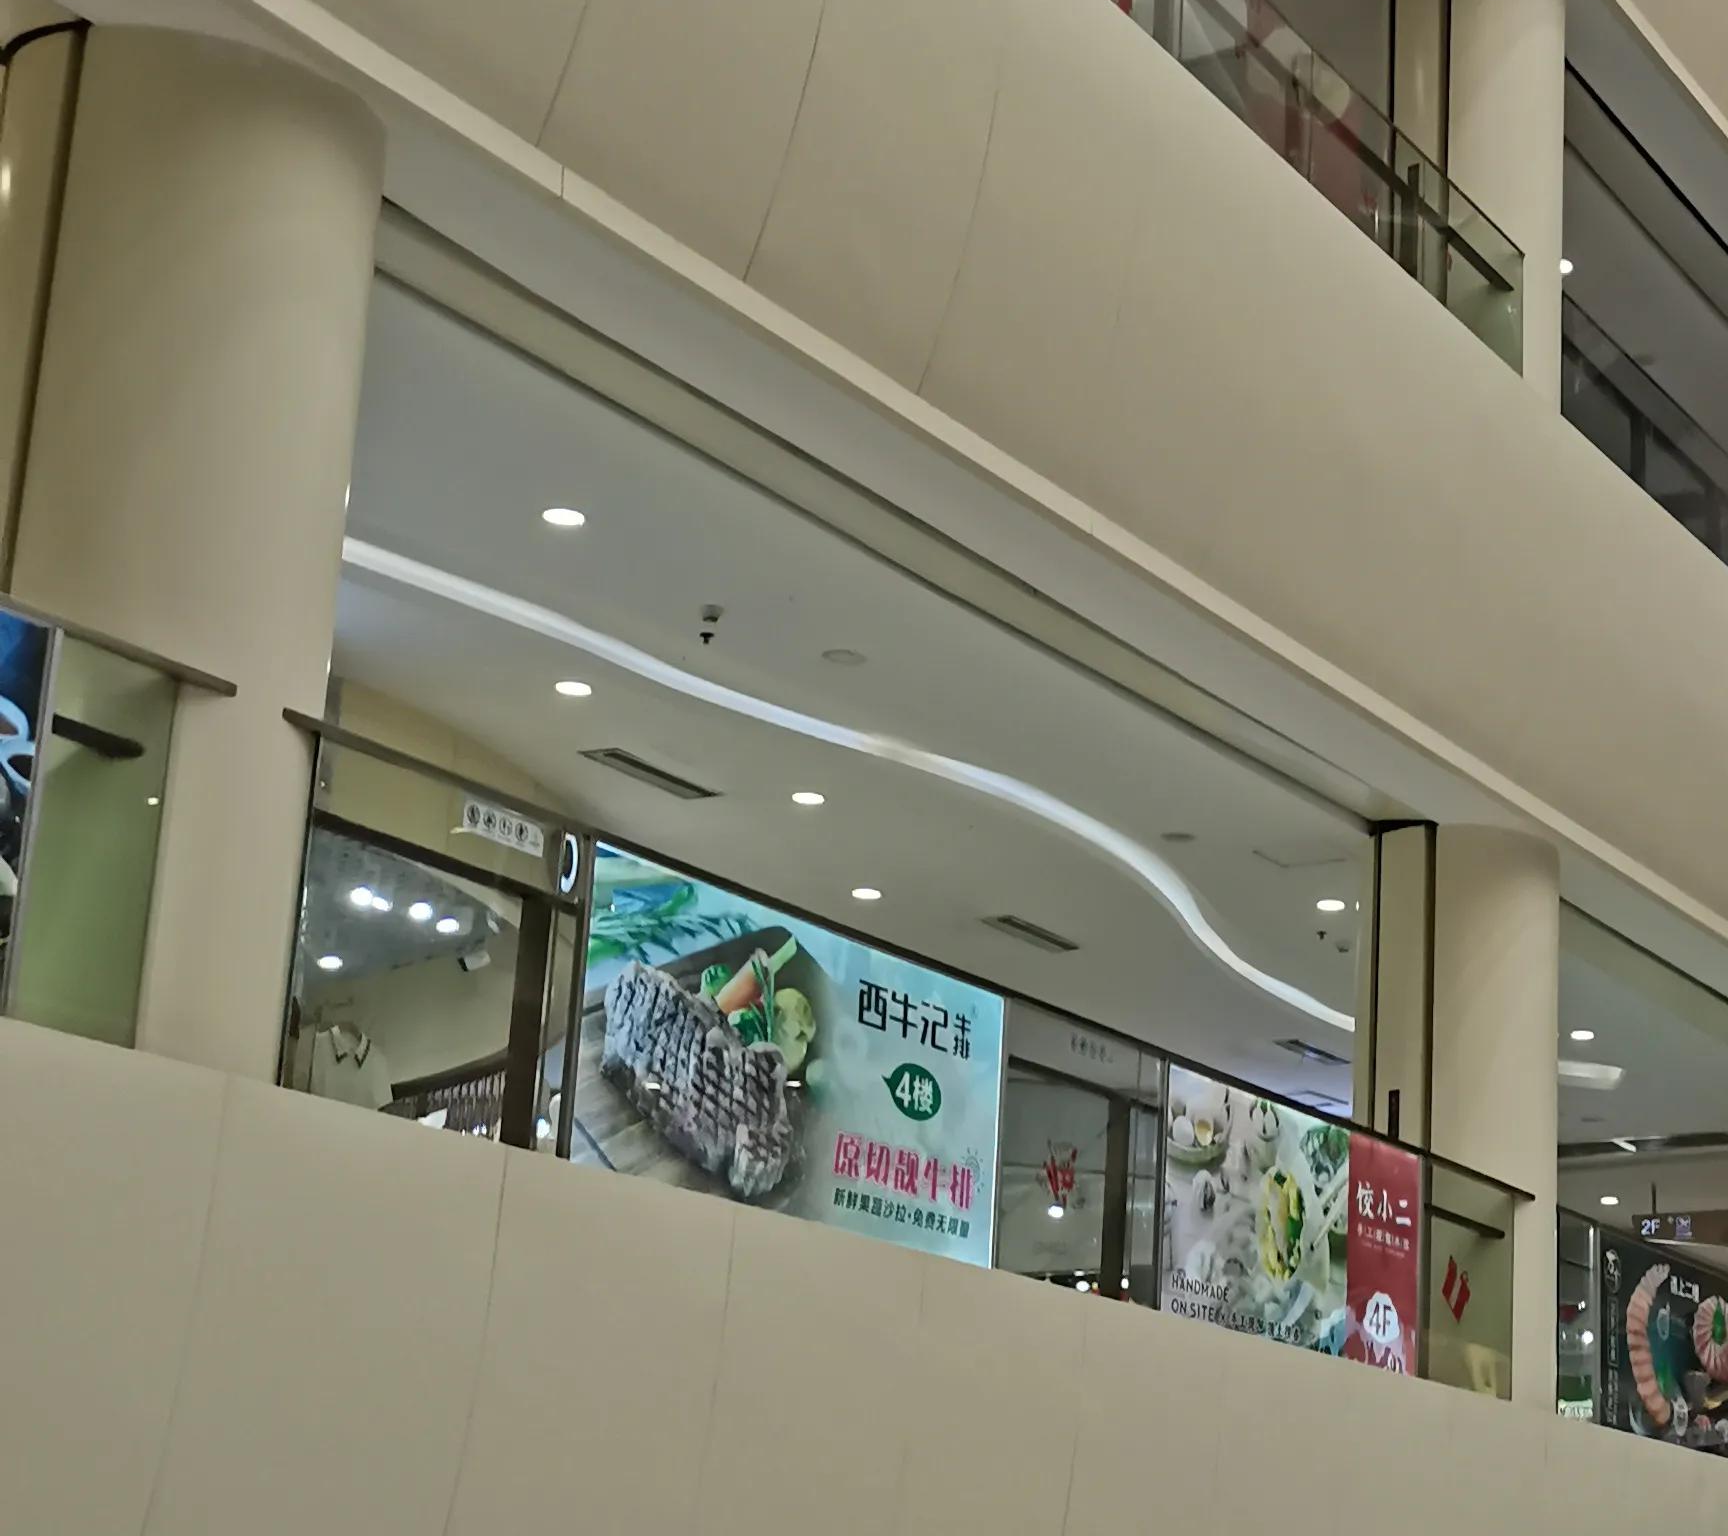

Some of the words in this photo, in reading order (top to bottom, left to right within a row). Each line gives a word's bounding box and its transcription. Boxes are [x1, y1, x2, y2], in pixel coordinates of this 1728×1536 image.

[895, 1071, 935, 1115] 4楼
[833, 1130, 973, 1210] 原切靓牛排
[1639, 1217, 1662, 1236] 2F
[1171, 1274, 1230, 1303] HANDMADE
[1171, 1298, 1187, 1316] ON
[1190, 1304, 1215, 1322] SITE
[1368, 1301, 1393, 1337] 4F
